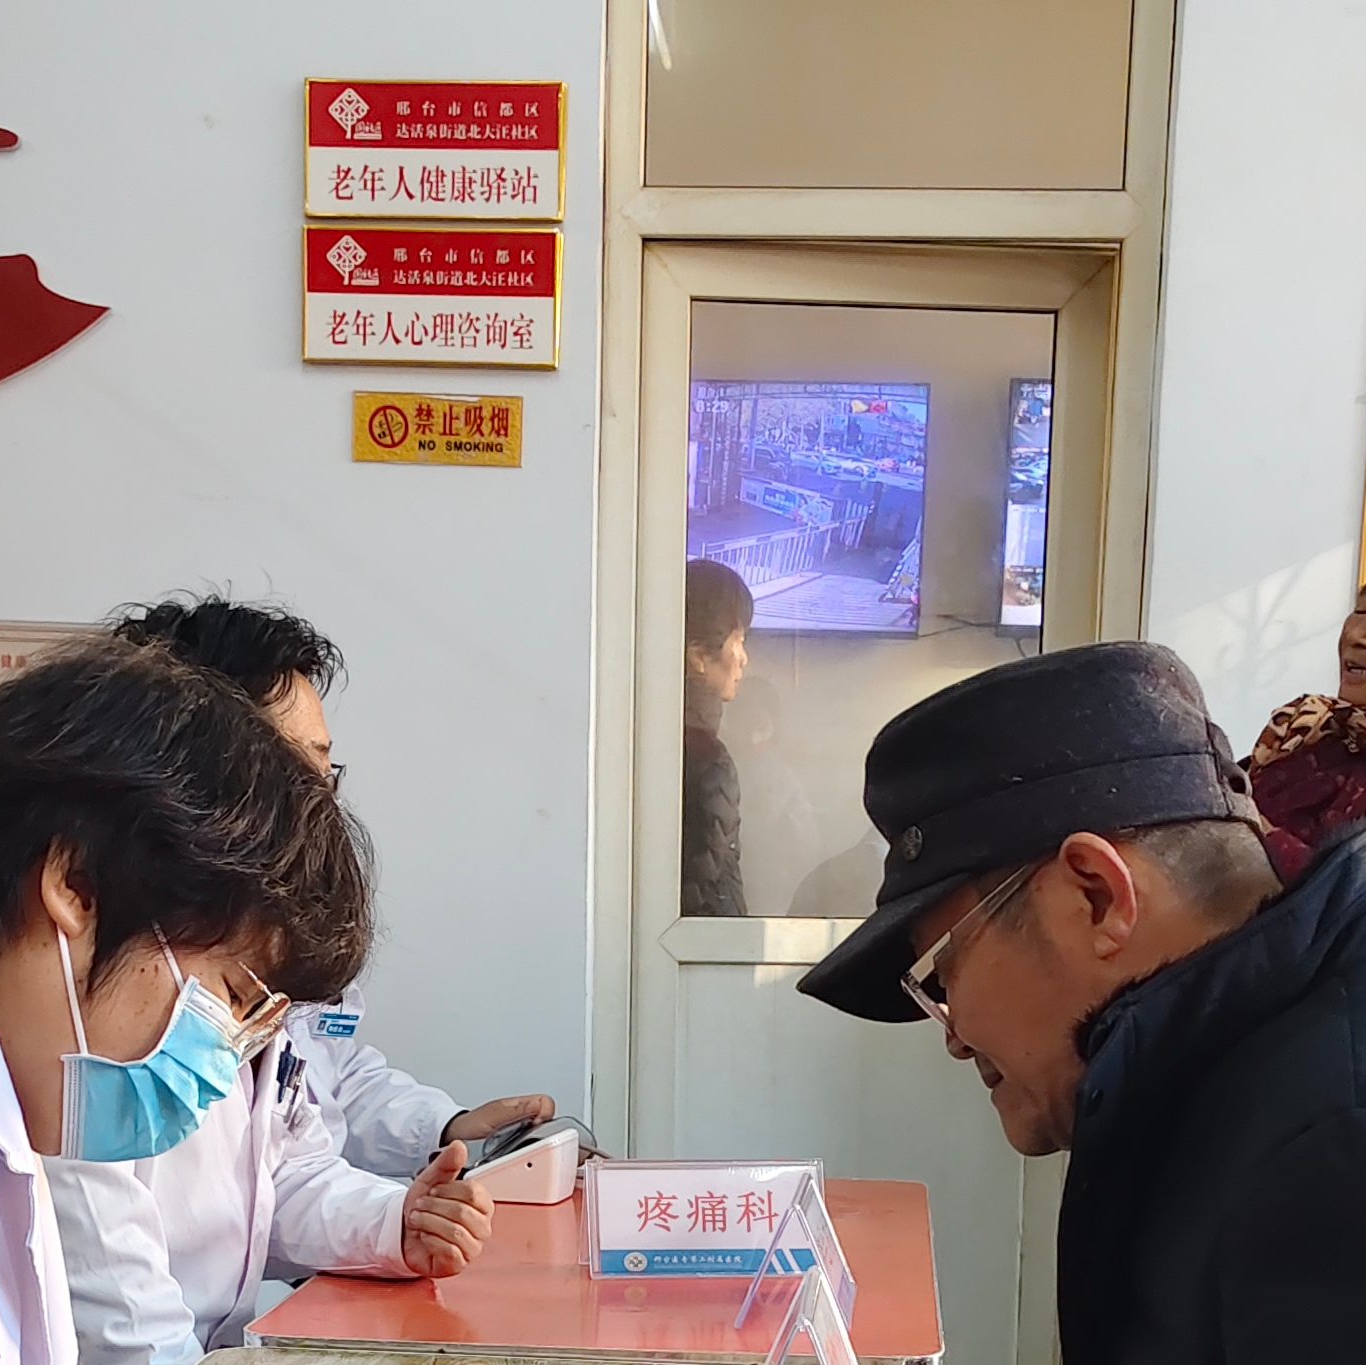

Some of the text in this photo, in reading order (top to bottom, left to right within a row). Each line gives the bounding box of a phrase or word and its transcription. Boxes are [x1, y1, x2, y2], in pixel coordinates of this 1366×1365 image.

[395, 100, 539, 117] 邢台市信都区
[327, 164, 539, 205] 老年人健康驿站
[325, 310, 535, 351] 老年人心理咨询室
[413, 403, 511, 438] 禁止吸烟
[417, 439, 504, 454] NO SMOKING
[636, 1189, 780, 1234] 疼痛科
